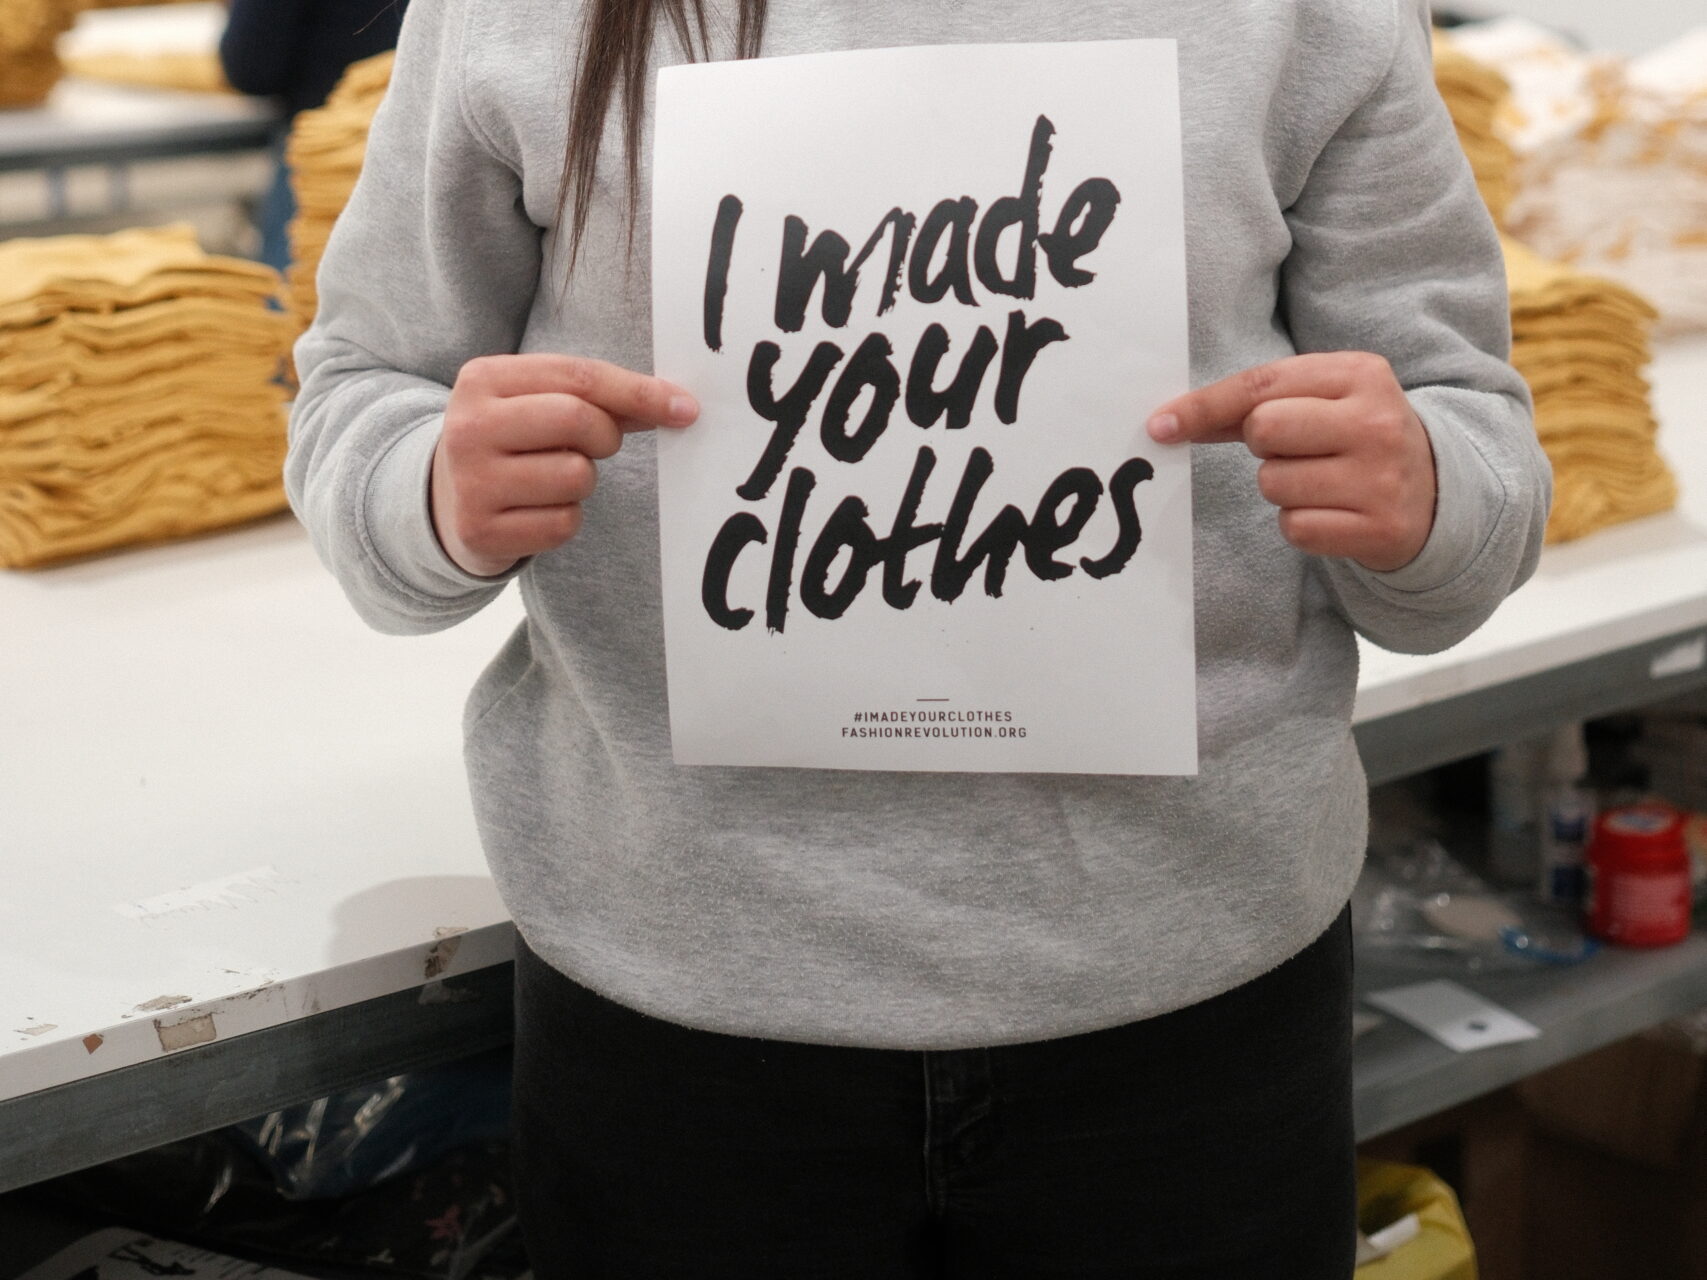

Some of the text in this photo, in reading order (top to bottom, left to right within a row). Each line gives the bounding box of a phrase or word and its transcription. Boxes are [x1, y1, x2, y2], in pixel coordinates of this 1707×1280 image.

[703, 114, 1121, 353] I made
[736, 309, 1070, 502] your
[702, 445, 1155, 634] clothes
[841, 726, 1027, 738] FASHIONREVOLUTION.ORG
[853, 710, 1013, 723] #IMADEYOURCLOTHES
